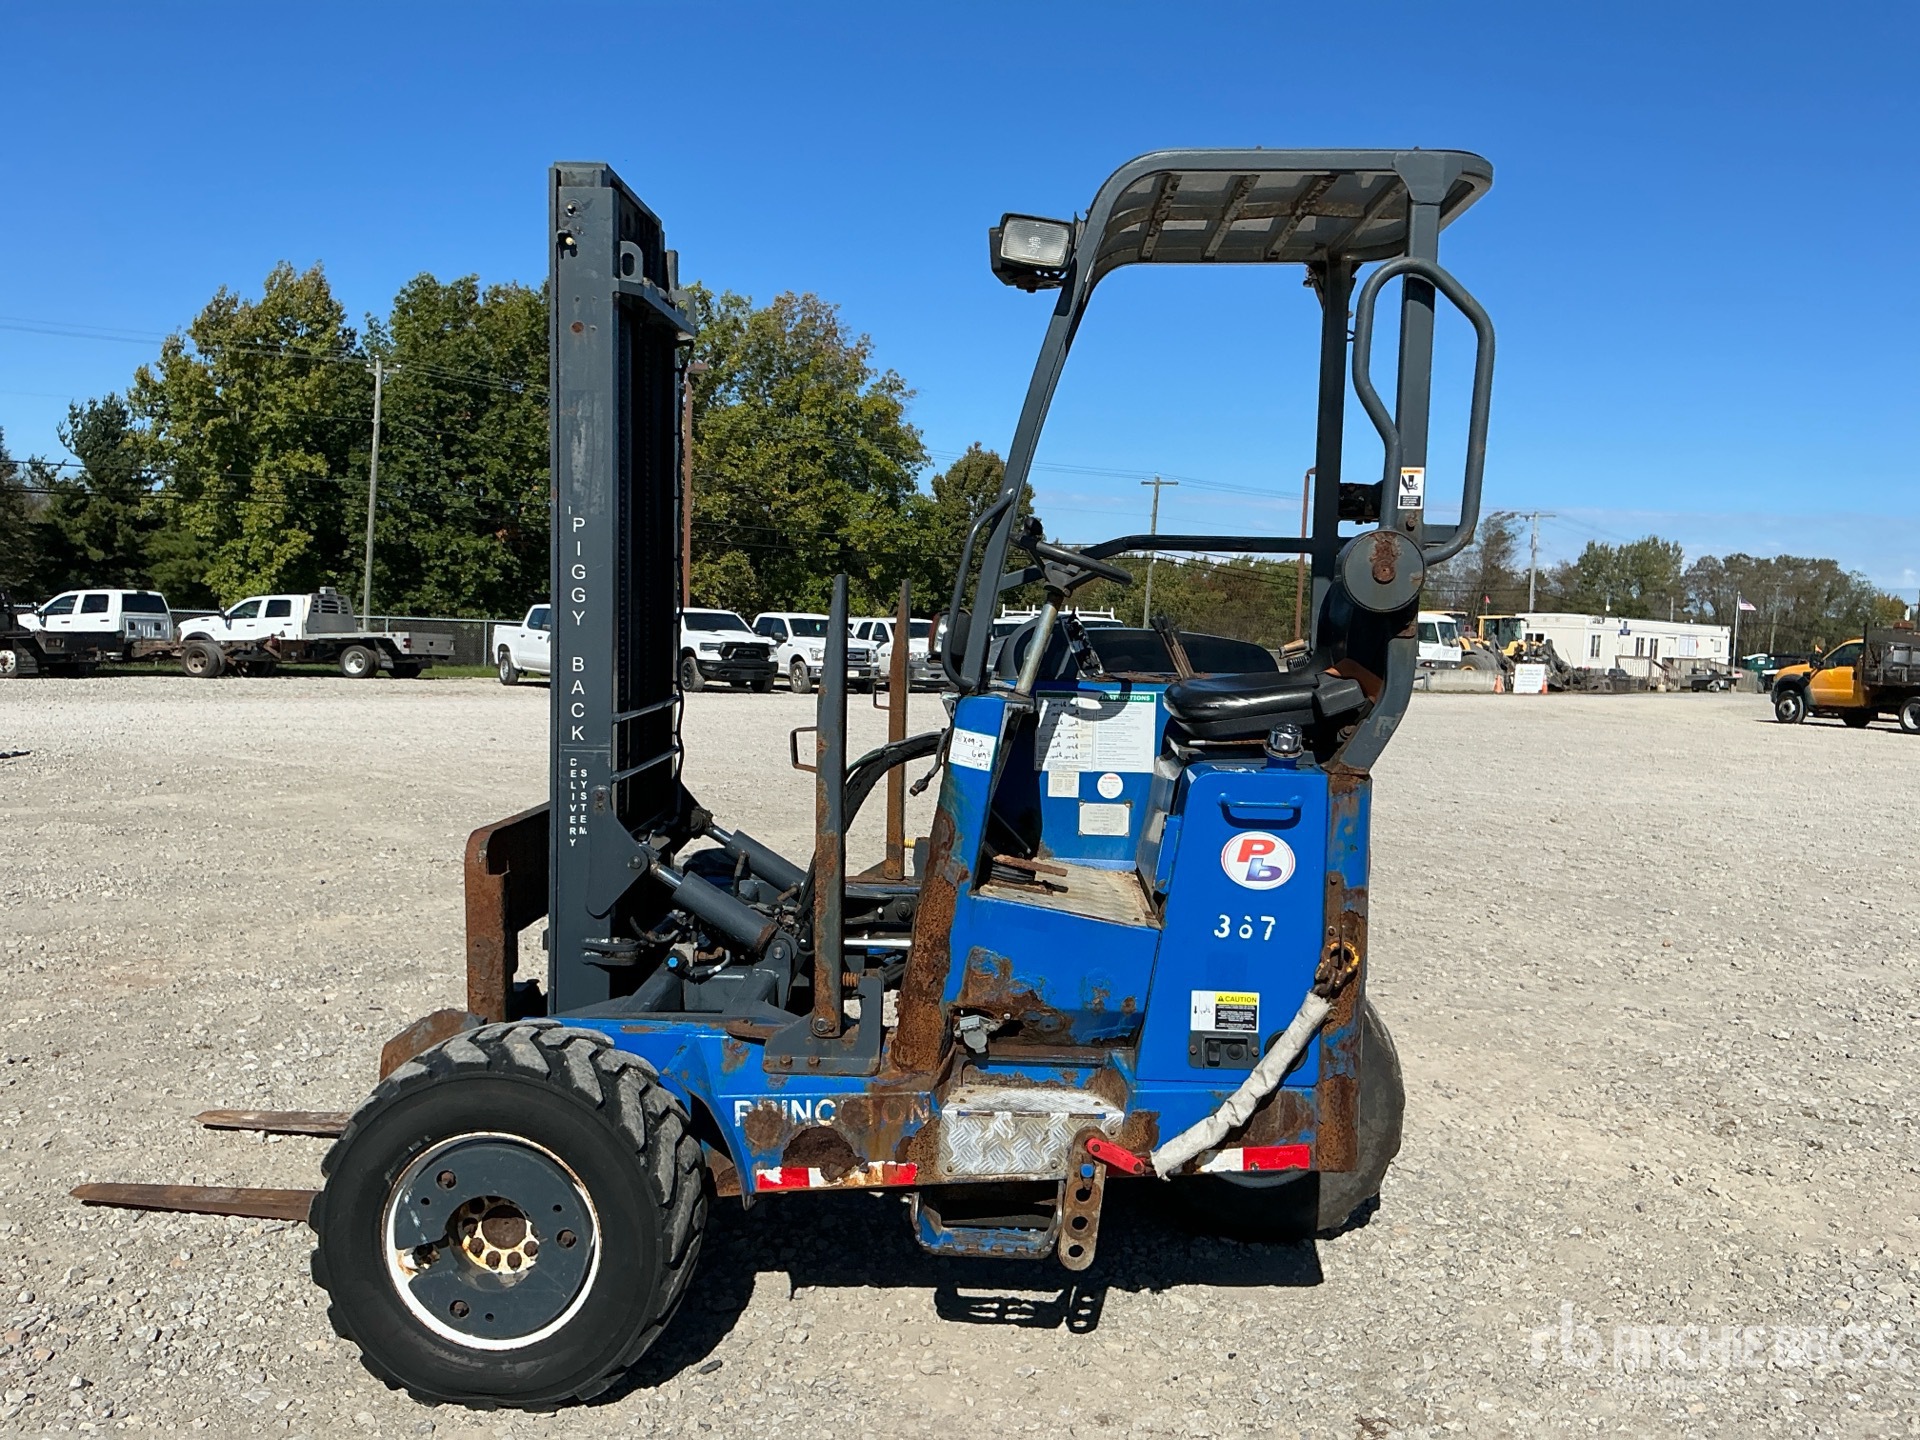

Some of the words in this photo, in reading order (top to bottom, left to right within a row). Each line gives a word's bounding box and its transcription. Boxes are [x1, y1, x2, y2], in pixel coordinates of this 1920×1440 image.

[571, 518, 587, 626] PIGGY
[571, 656, 586, 741] BACK
[1101, 694, 1151, 702] INSTRUCTIONS
[1213, 914, 1276, 941] 367
[1225, 995, 1257, 1003] CAUTION
